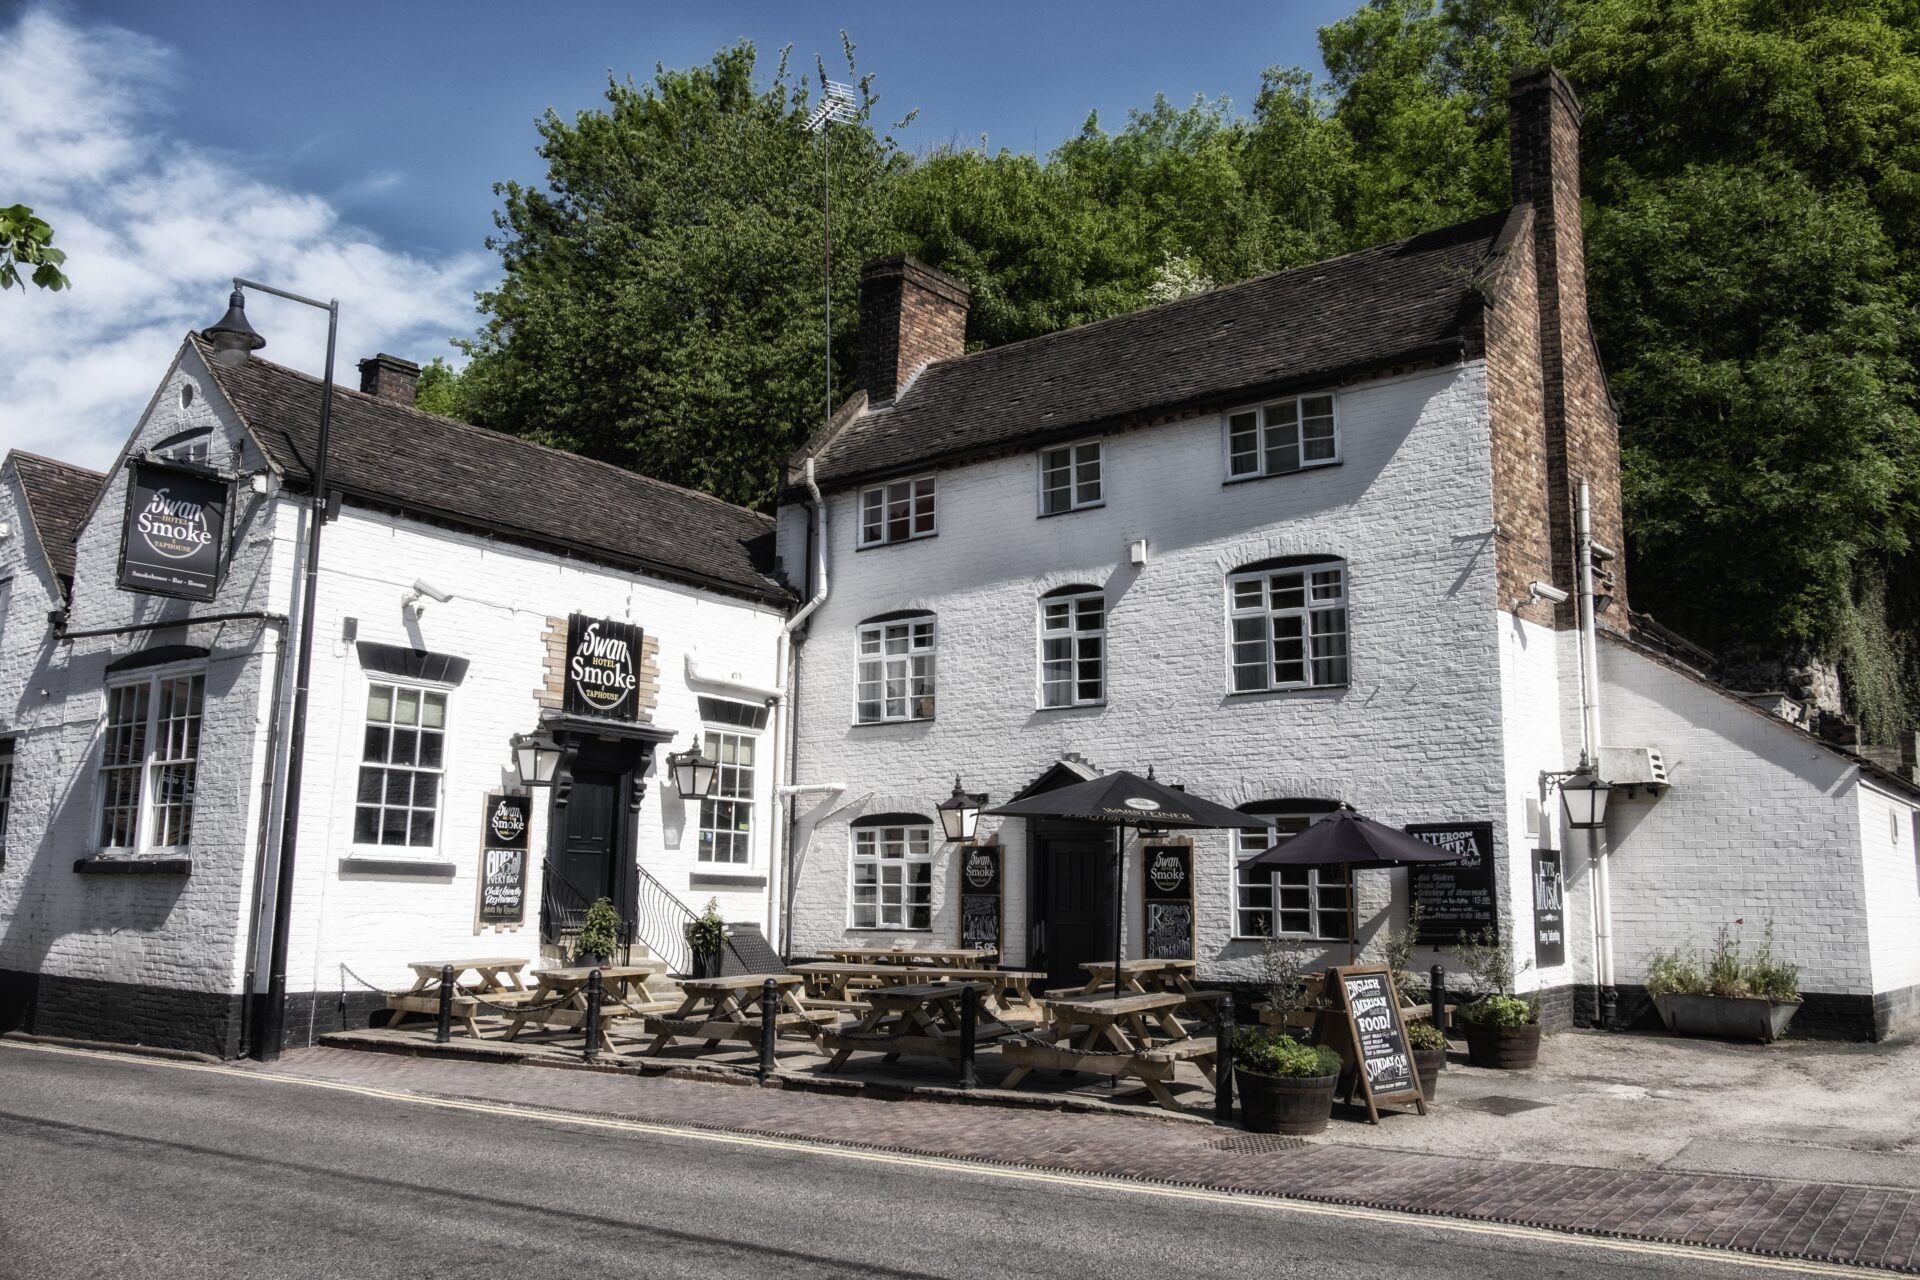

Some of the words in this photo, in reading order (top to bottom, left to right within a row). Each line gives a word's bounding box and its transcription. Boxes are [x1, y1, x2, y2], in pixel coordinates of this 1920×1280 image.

[150, 488, 202, 521] Swan
[138, 512, 212, 545] Smoke
[162, 515, 190, 526] HOTEL
[154, 541, 192, 553] TAPHOUSE
[131, 570, 168, 582] Smokehouse
[187, 580, 207, 588] Rooms
[582, 623, 627, 663] Swan
[592, 657, 616, 668] HOTEL
[571, 655, 636, 690] Smoke
[585, 689, 620, 701] TAPHOUSE
[497, 800, 520, 818] Swan
[1102, 807, 1195, 821] WARSTEINER
[491, 816, 525, 830] Smoke
[486, 850, 514, 877] OPEN
[970, 850, 991, 866] Swan
[1155, 851, 1179, 868] Swan
[486, 874, 506, 884] EVERY
[506, 875, 519, 884] DAY
[966, 865, 995, 877] Smoke
[1150, 867, 1185, 880] Smoke
[1345, 979, 1381, 1001] ENGLISH
[1351, 996, 1387, 1019] AMERICAN
[1365, 1055, 1395, 1082] SUNDAY
